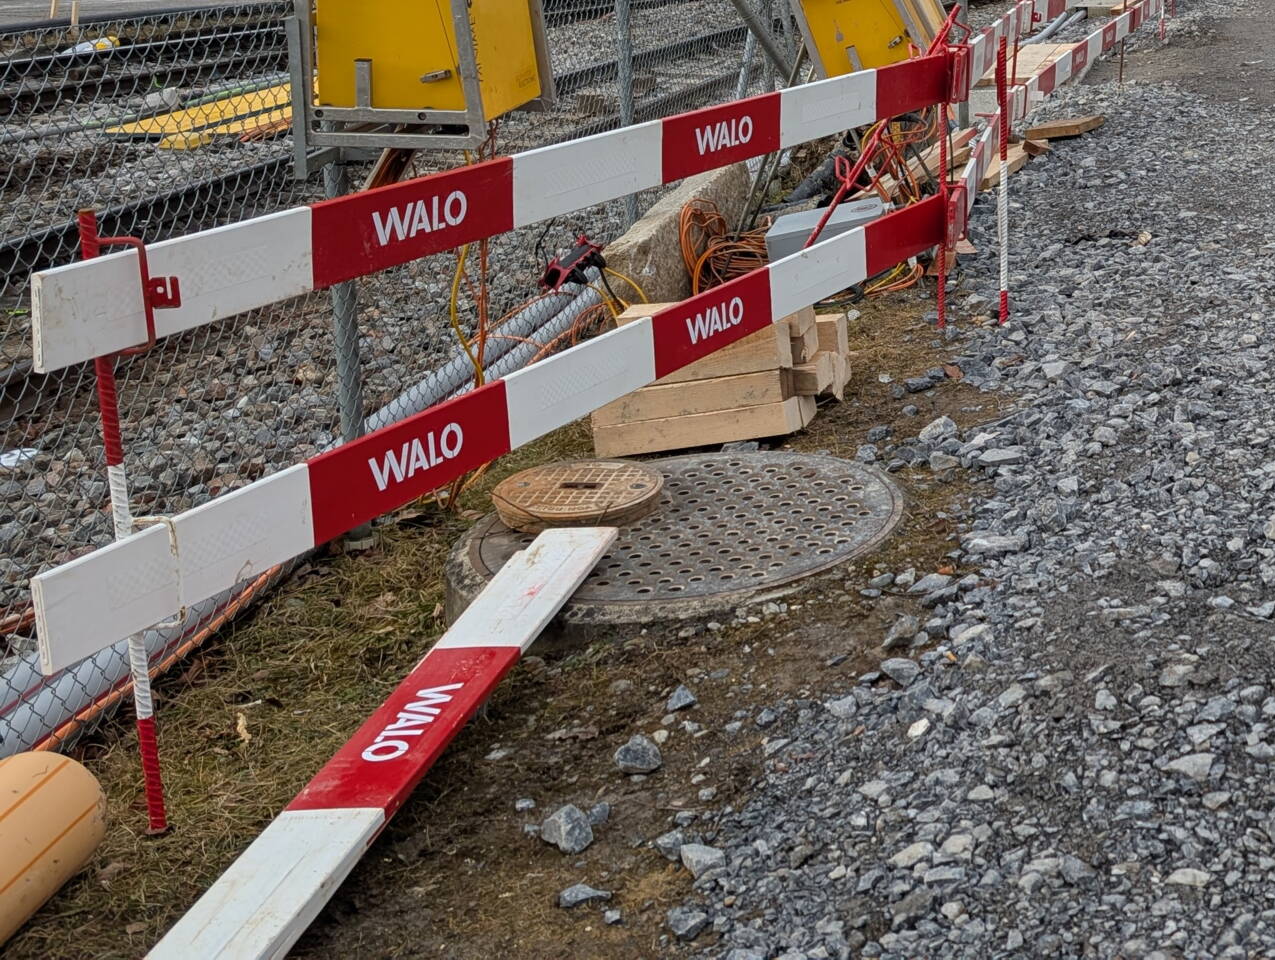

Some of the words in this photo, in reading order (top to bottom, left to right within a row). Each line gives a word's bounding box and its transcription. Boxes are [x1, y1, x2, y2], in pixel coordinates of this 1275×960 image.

[695, 115, 753, 155] WALO
[371, 190, 467, 245] WALO
[685, 296, 744, 345] WALO
[367, 422, 464, 490] WALO
[361, 682, 466, 762] WALO
